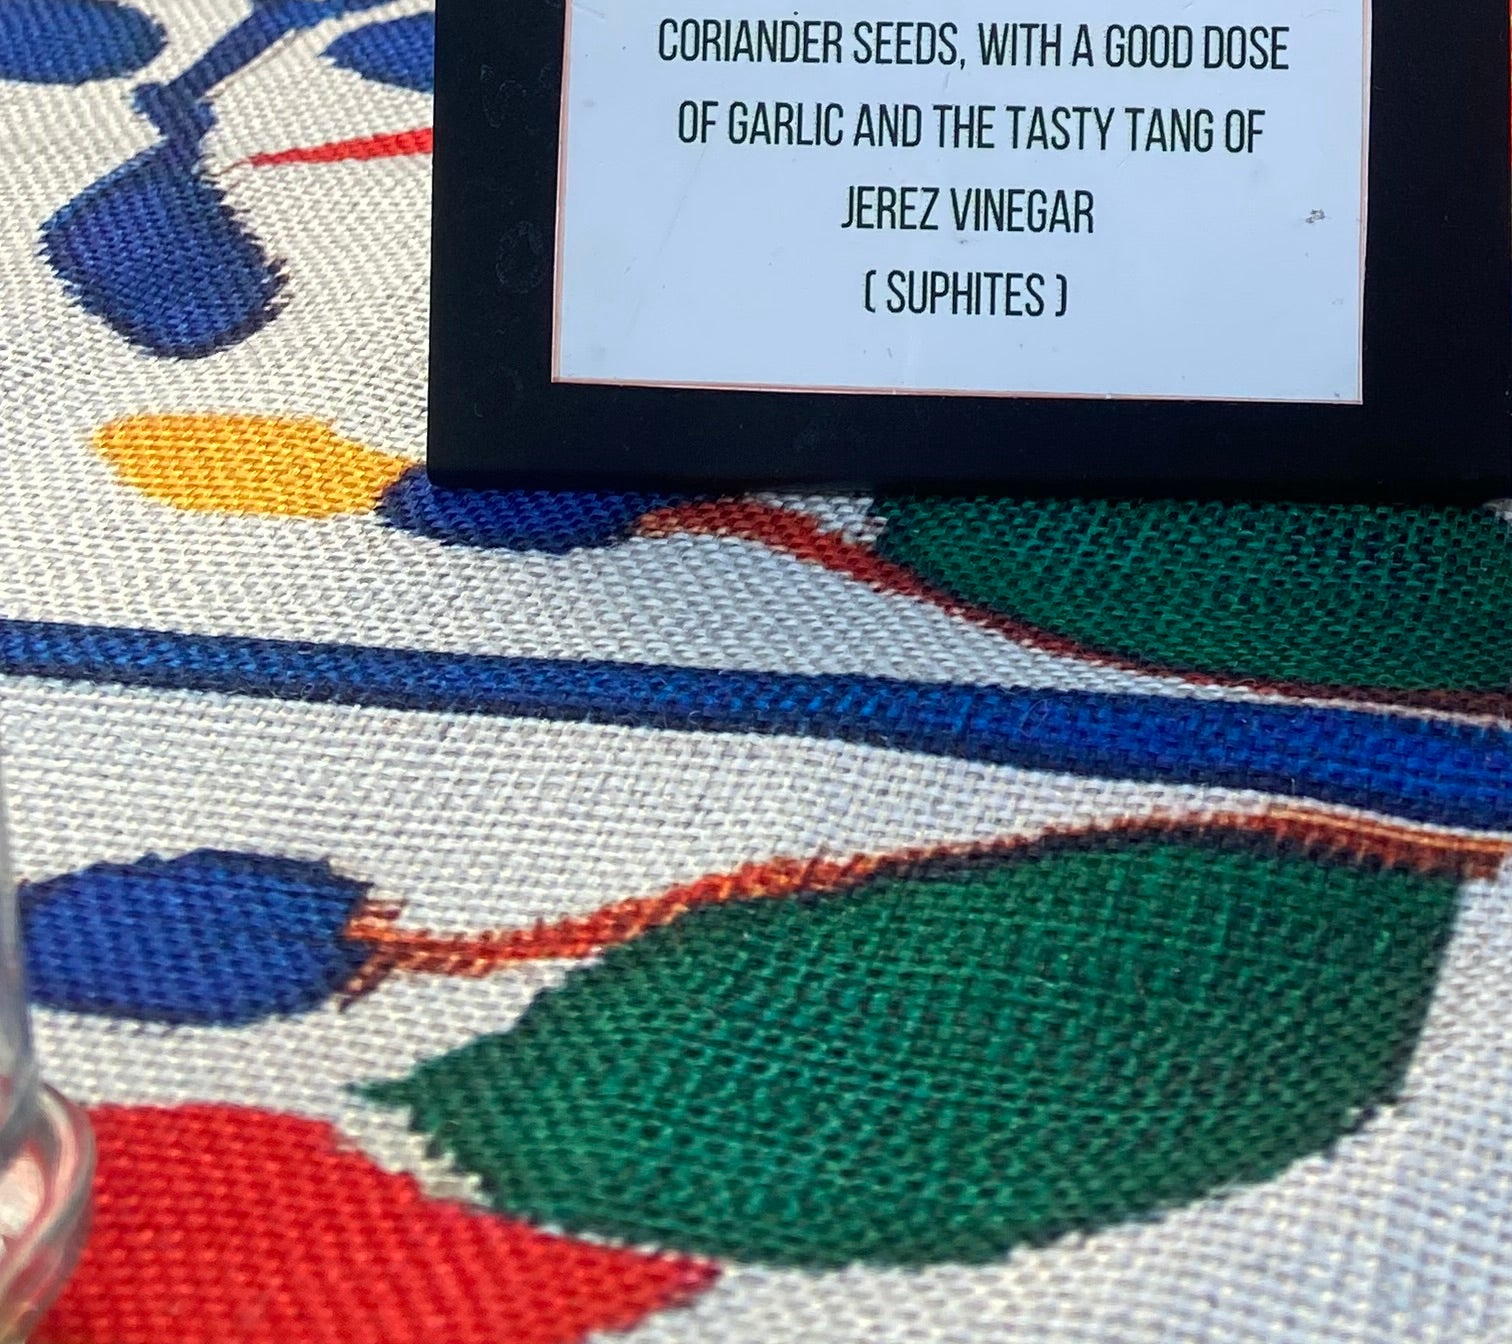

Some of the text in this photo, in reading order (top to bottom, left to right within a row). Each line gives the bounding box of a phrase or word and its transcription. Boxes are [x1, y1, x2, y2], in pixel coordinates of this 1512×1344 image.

[659, 18, 1290, 70] CORIANDER SEEDS, WITH A GOOD DOSE
[679, 100, 1266, 154] OF GARLIC AND THE TASTY TANG OF
[841, 186, 1094, 233] JEREZ VINEGAR
[887, 269, 1045, 317] SUPHITES
